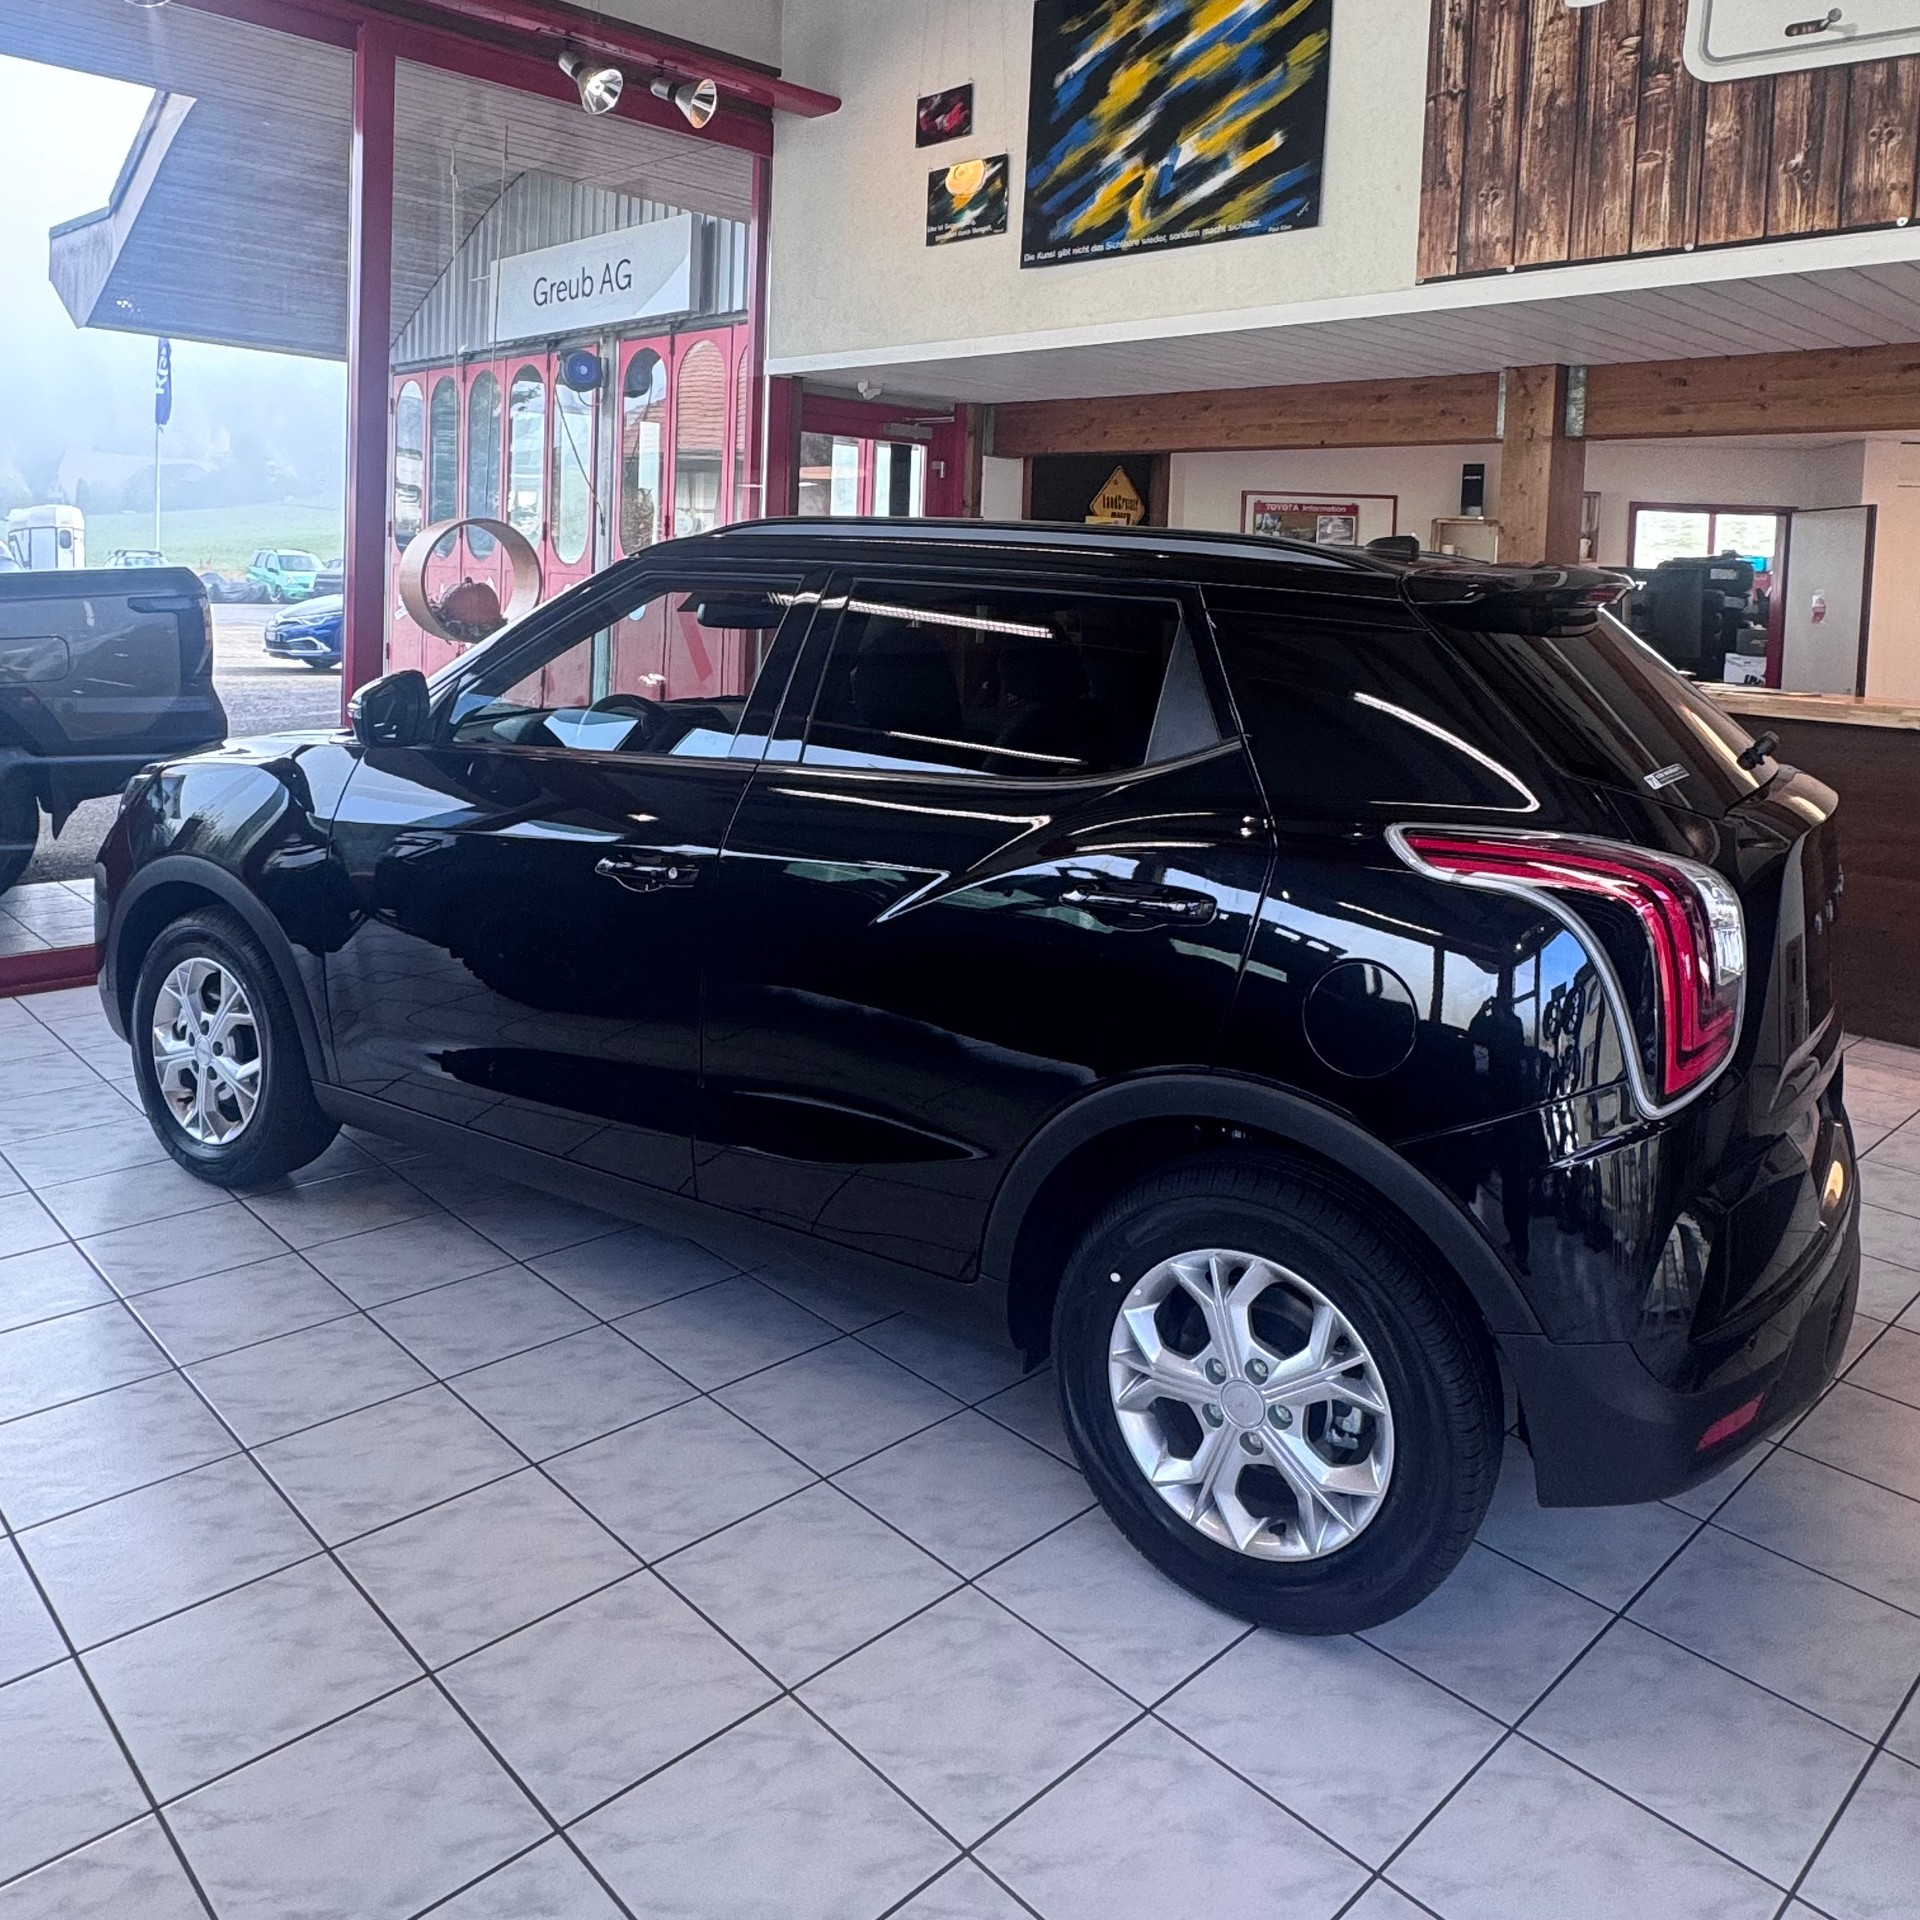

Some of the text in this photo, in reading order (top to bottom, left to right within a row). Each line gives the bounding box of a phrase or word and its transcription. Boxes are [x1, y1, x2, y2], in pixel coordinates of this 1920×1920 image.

[1023, 253, 1036, 262] Die
[1036, 250, 1056, 260] Kunst
[1057, 247, 1072, 258] gibt
[1072, 245, 1090, 255] nicht
[1091, 243, 1104, 253] das
[1168, 229, 1200, 241] sondern
[1202, 223, 1226, 236] macht
[533, 258, 632, 306] Greub AG
[1265, 503, 1347, 513] TOYOTA Information
